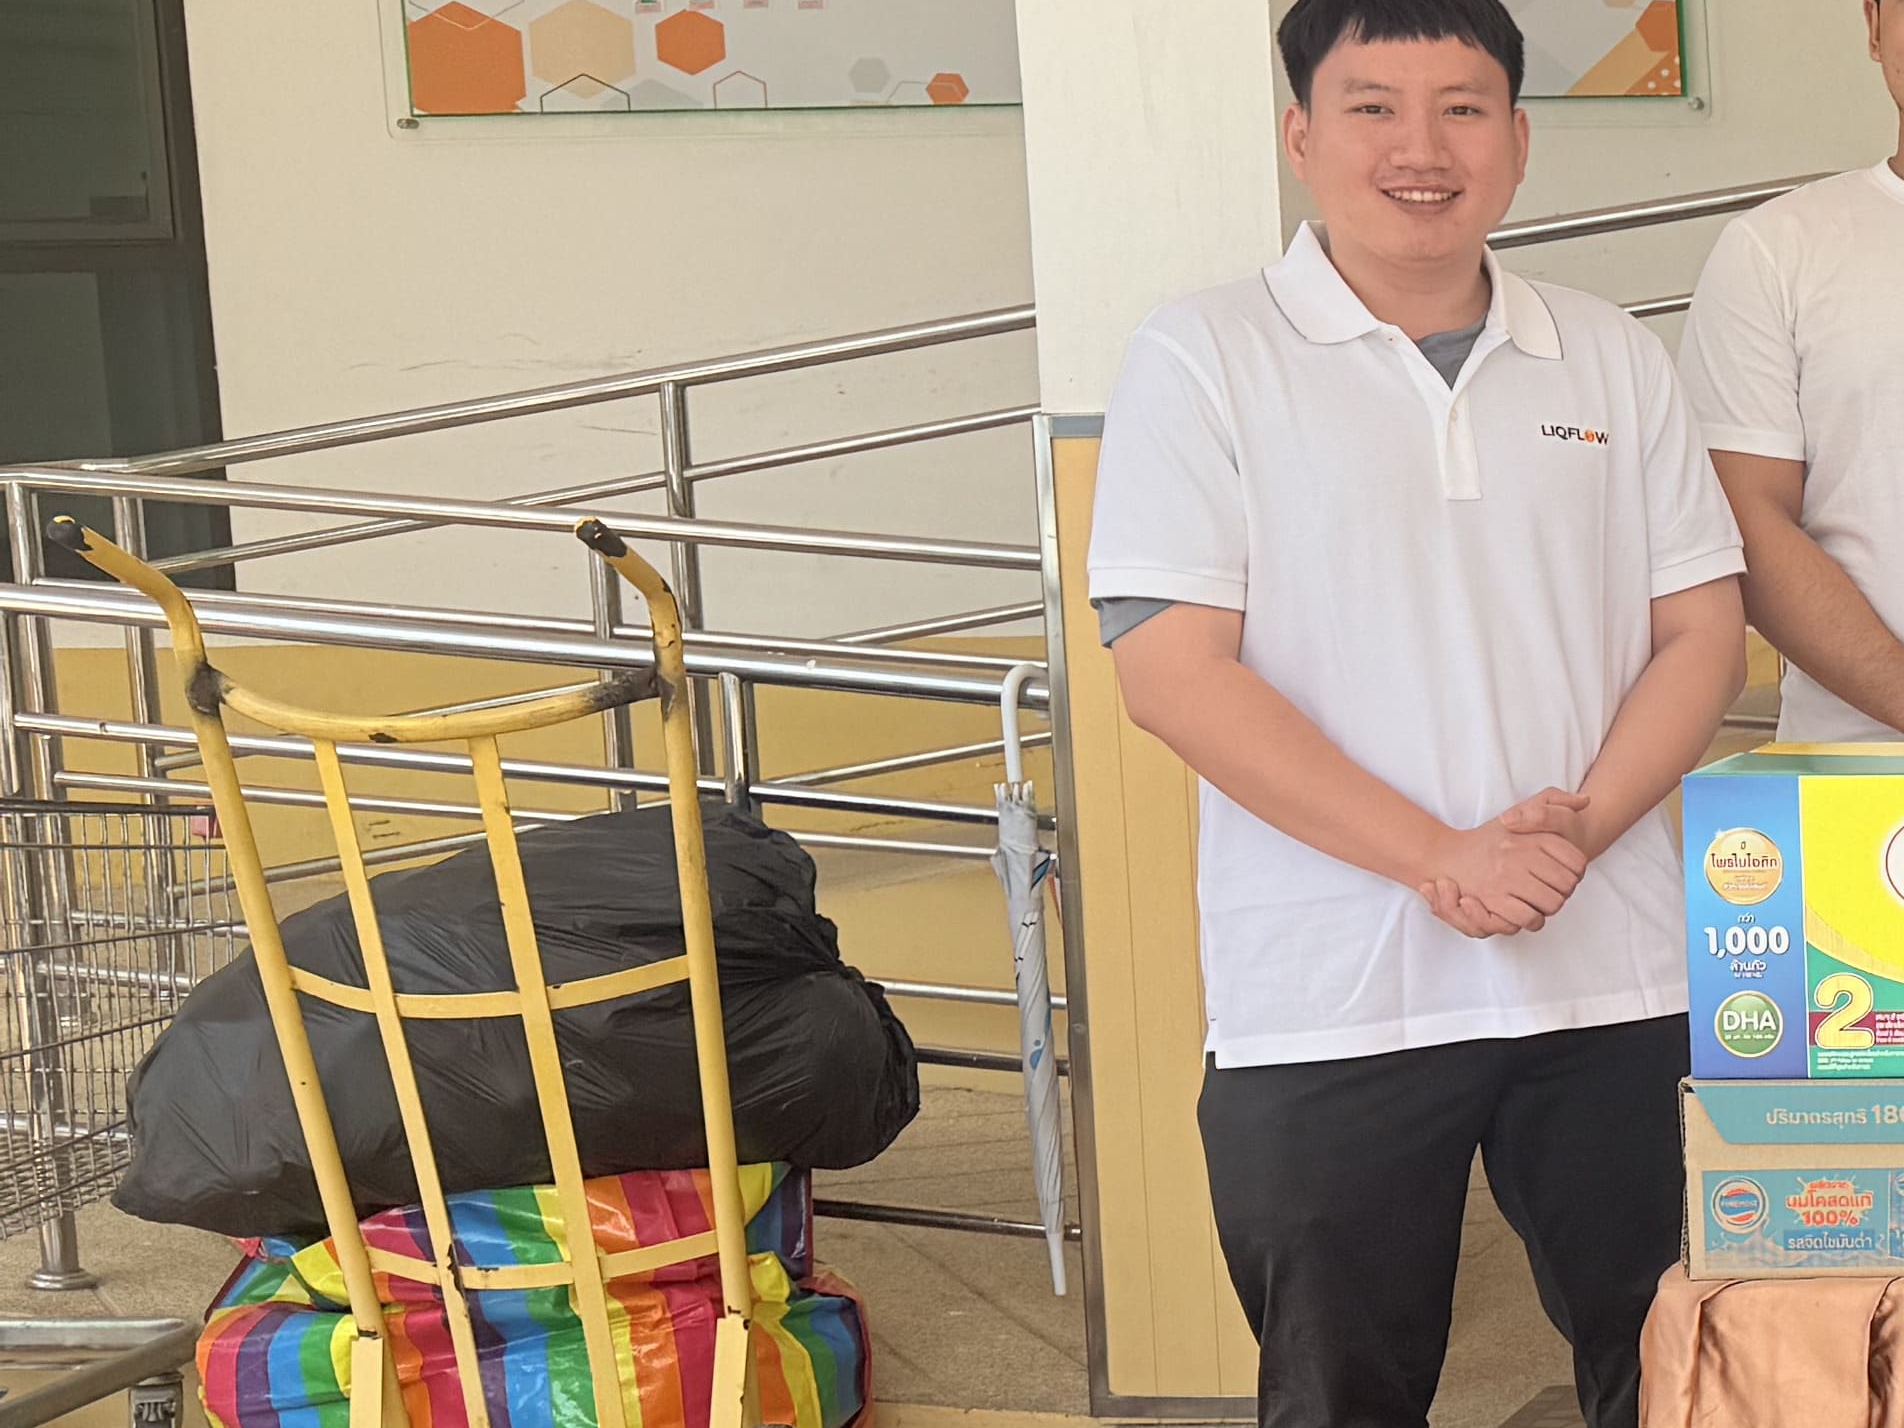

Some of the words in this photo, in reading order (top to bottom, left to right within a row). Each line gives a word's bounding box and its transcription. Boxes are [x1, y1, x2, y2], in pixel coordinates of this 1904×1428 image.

[1541, 422, 1610, 447] LIQFLOW
[1704, 926, 1790, 958] 1,000
[1723, 1010, 1776, 1031] DHA
[1814, 972, 1874, 1048] 2
[1801, 1210, 1859, 1226] 100%
